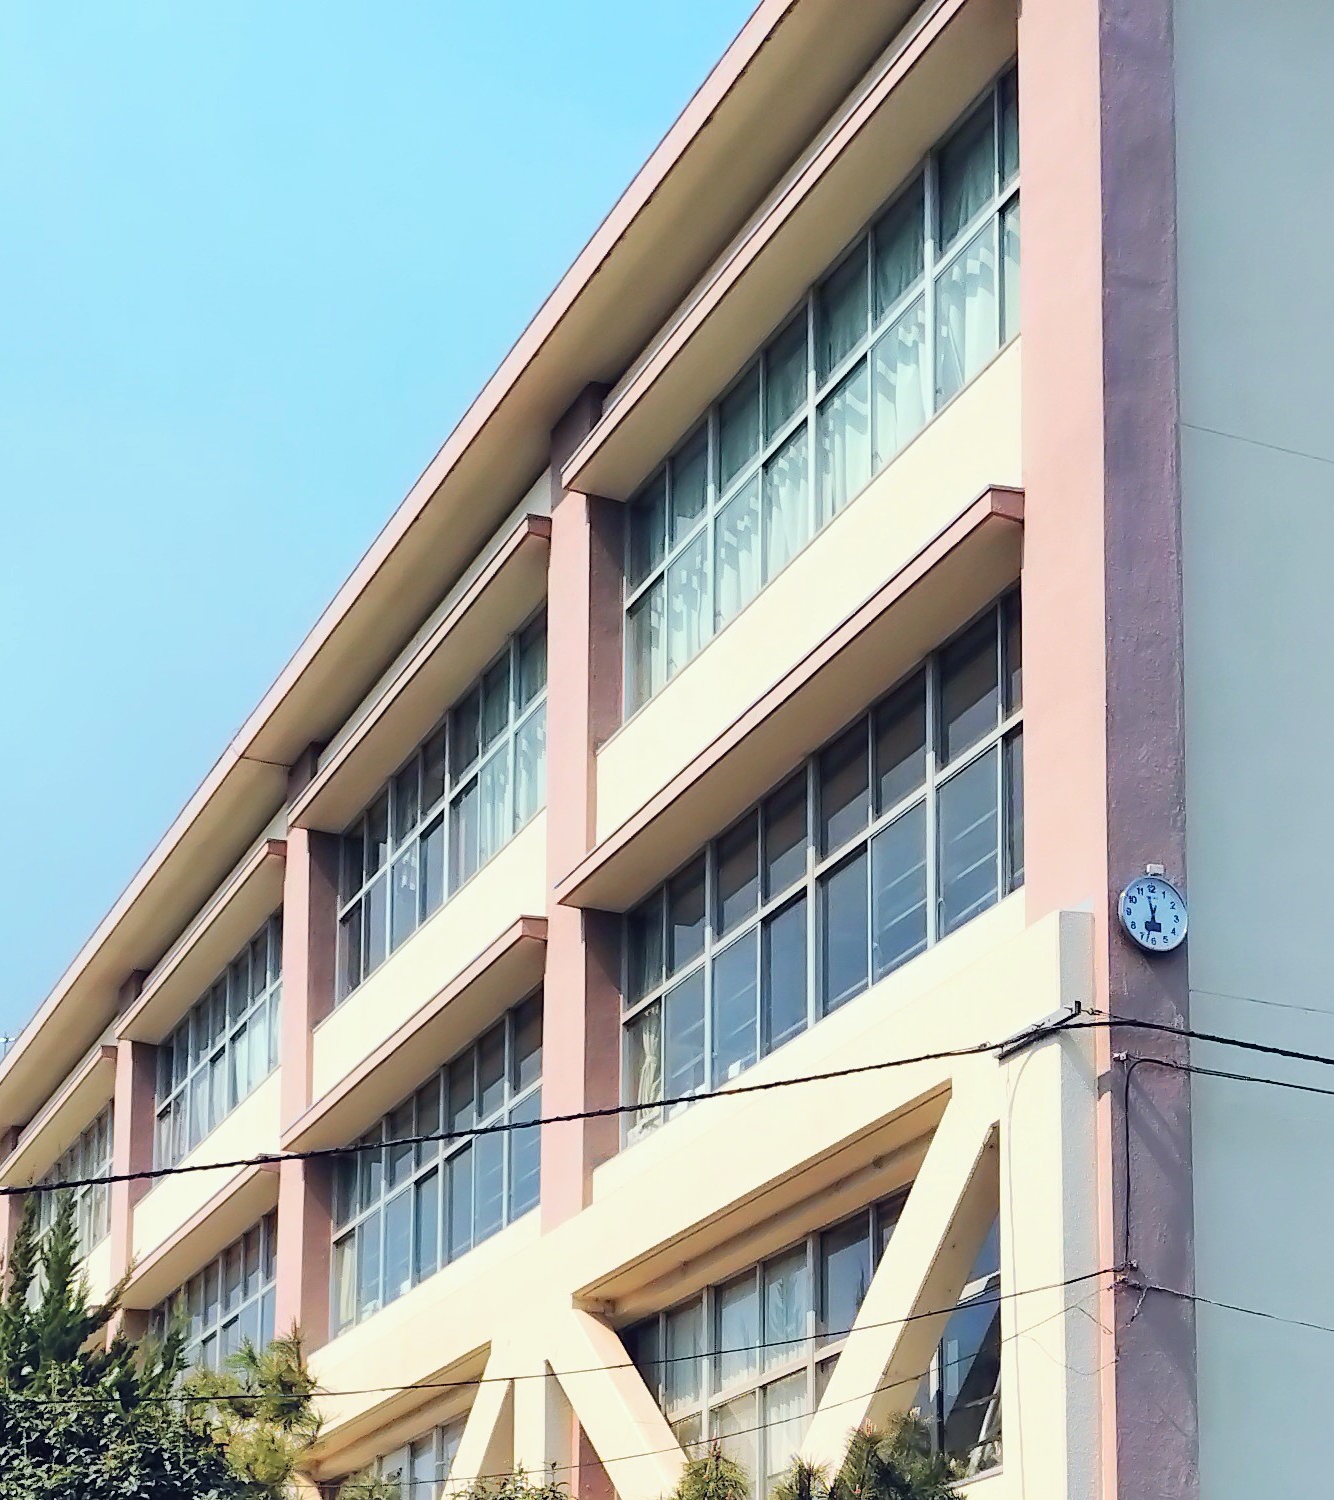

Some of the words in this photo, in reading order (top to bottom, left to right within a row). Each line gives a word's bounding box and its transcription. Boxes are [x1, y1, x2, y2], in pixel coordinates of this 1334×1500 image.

[1137, 887, 1144, 896] 11
[1147, 884, 1156, 893] 12
[1128, 896, 1137, 904] 10
